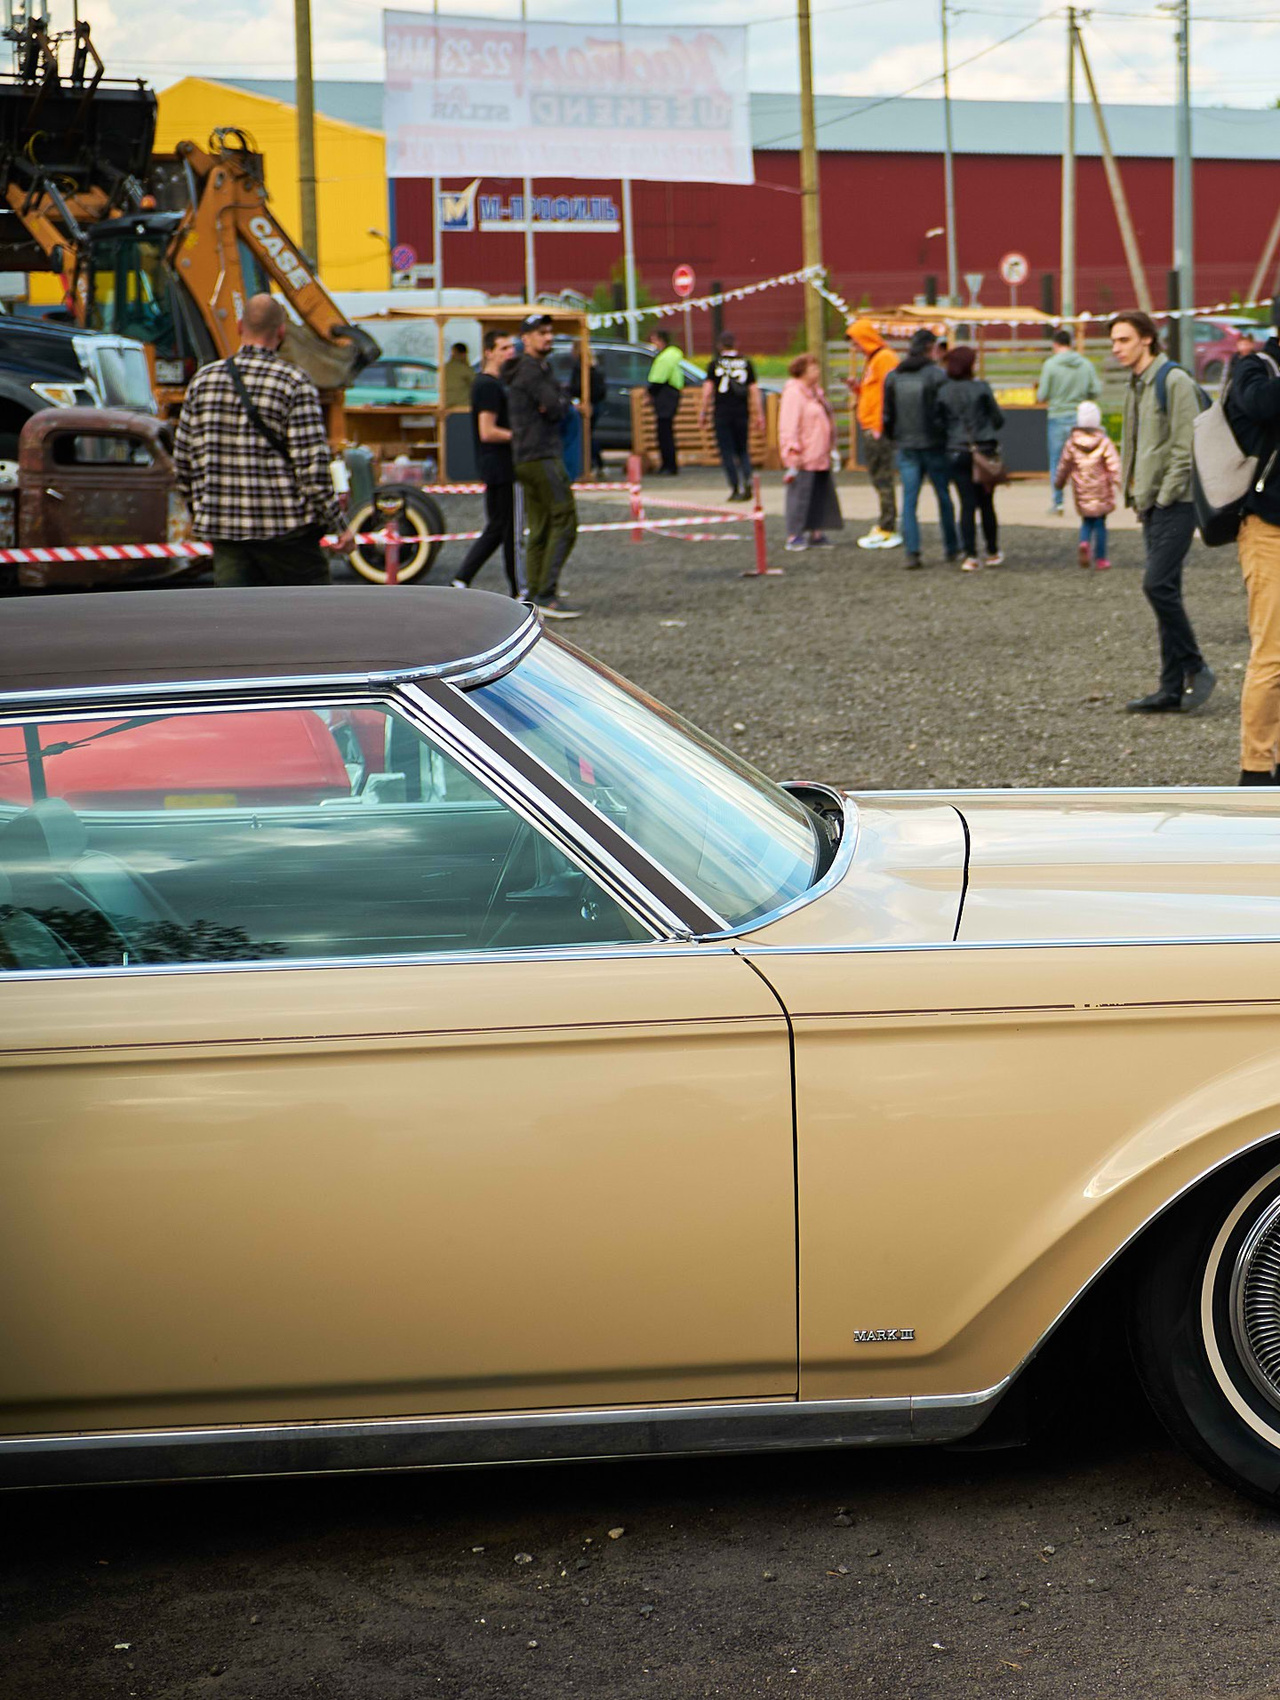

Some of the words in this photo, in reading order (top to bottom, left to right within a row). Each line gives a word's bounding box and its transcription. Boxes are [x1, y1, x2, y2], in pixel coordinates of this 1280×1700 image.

[249, 215, 312, 291] CASE
[853, 1329, 898, 1342] MARK
[899, 1328, 916, 1341] III
